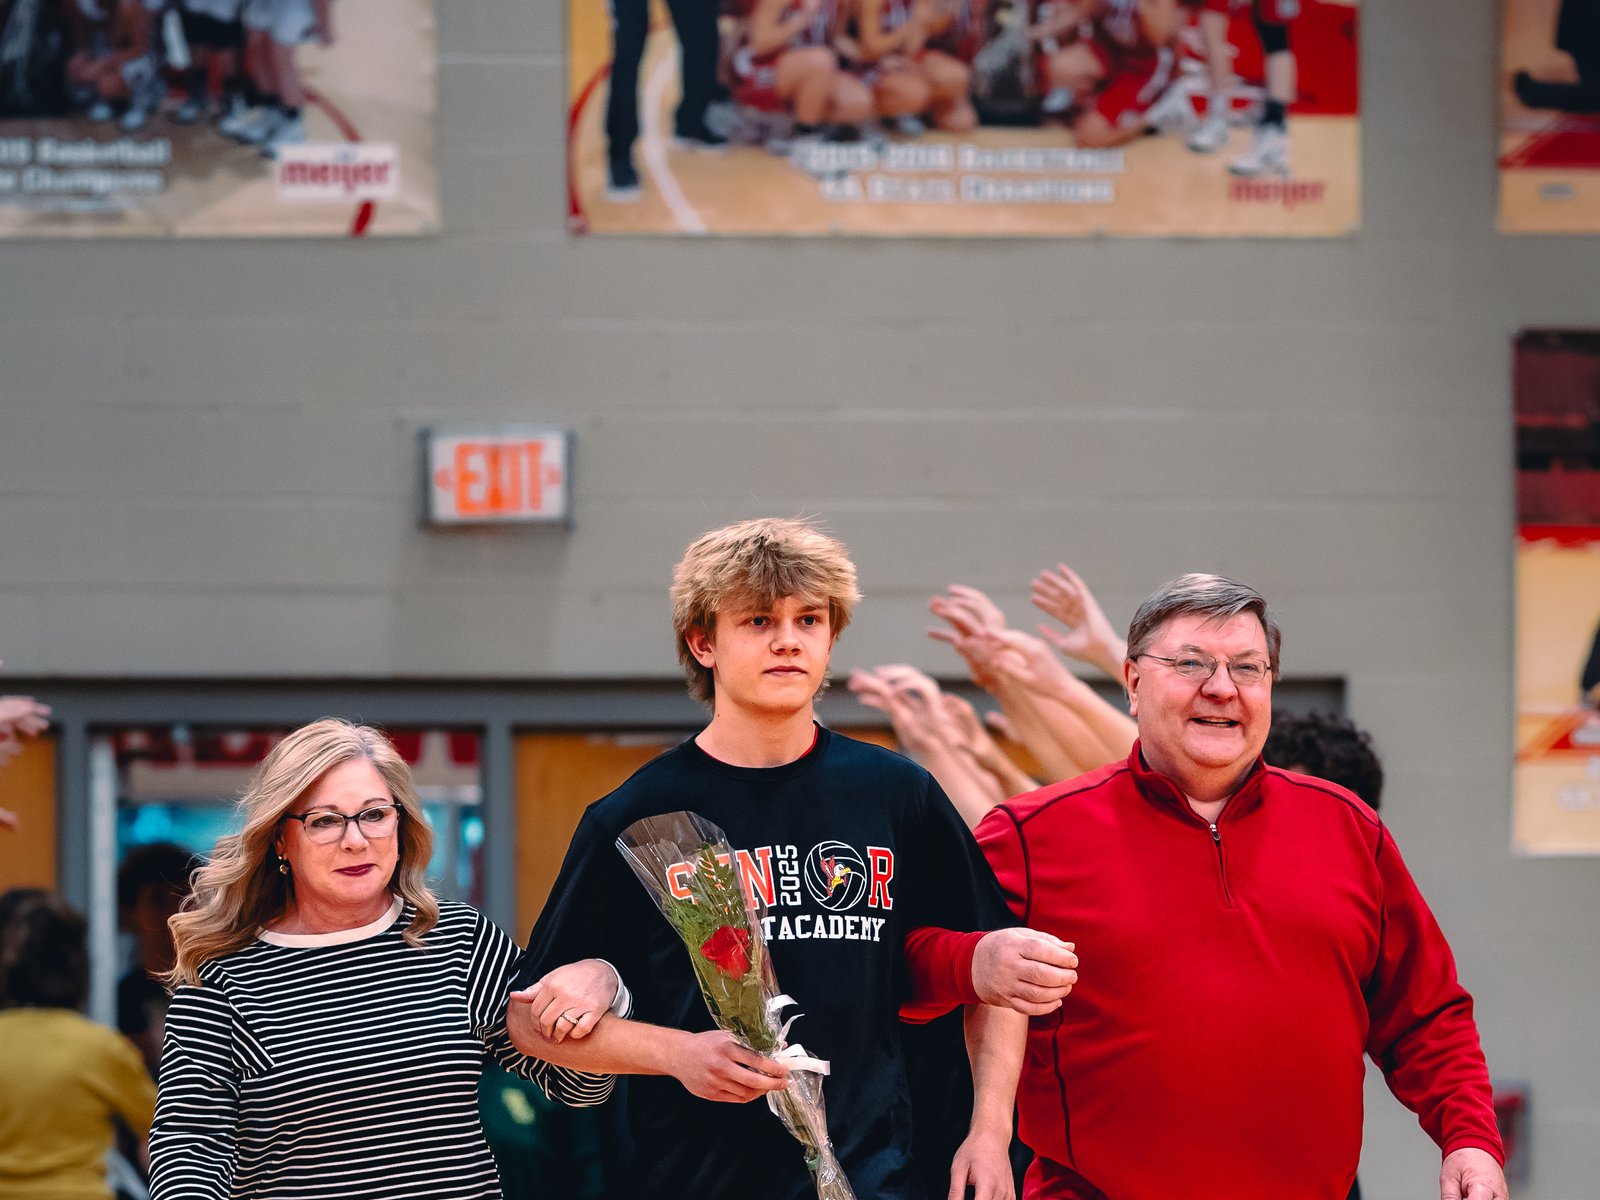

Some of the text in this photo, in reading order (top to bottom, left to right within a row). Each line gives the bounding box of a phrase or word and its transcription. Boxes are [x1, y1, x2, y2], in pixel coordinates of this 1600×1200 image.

[281, 152, 388, 193] meijer
[1226, 177, 1325, 209] meijer
[454, 442, 544, 517] EXIT
[775, 844, 801, 906] 2025
